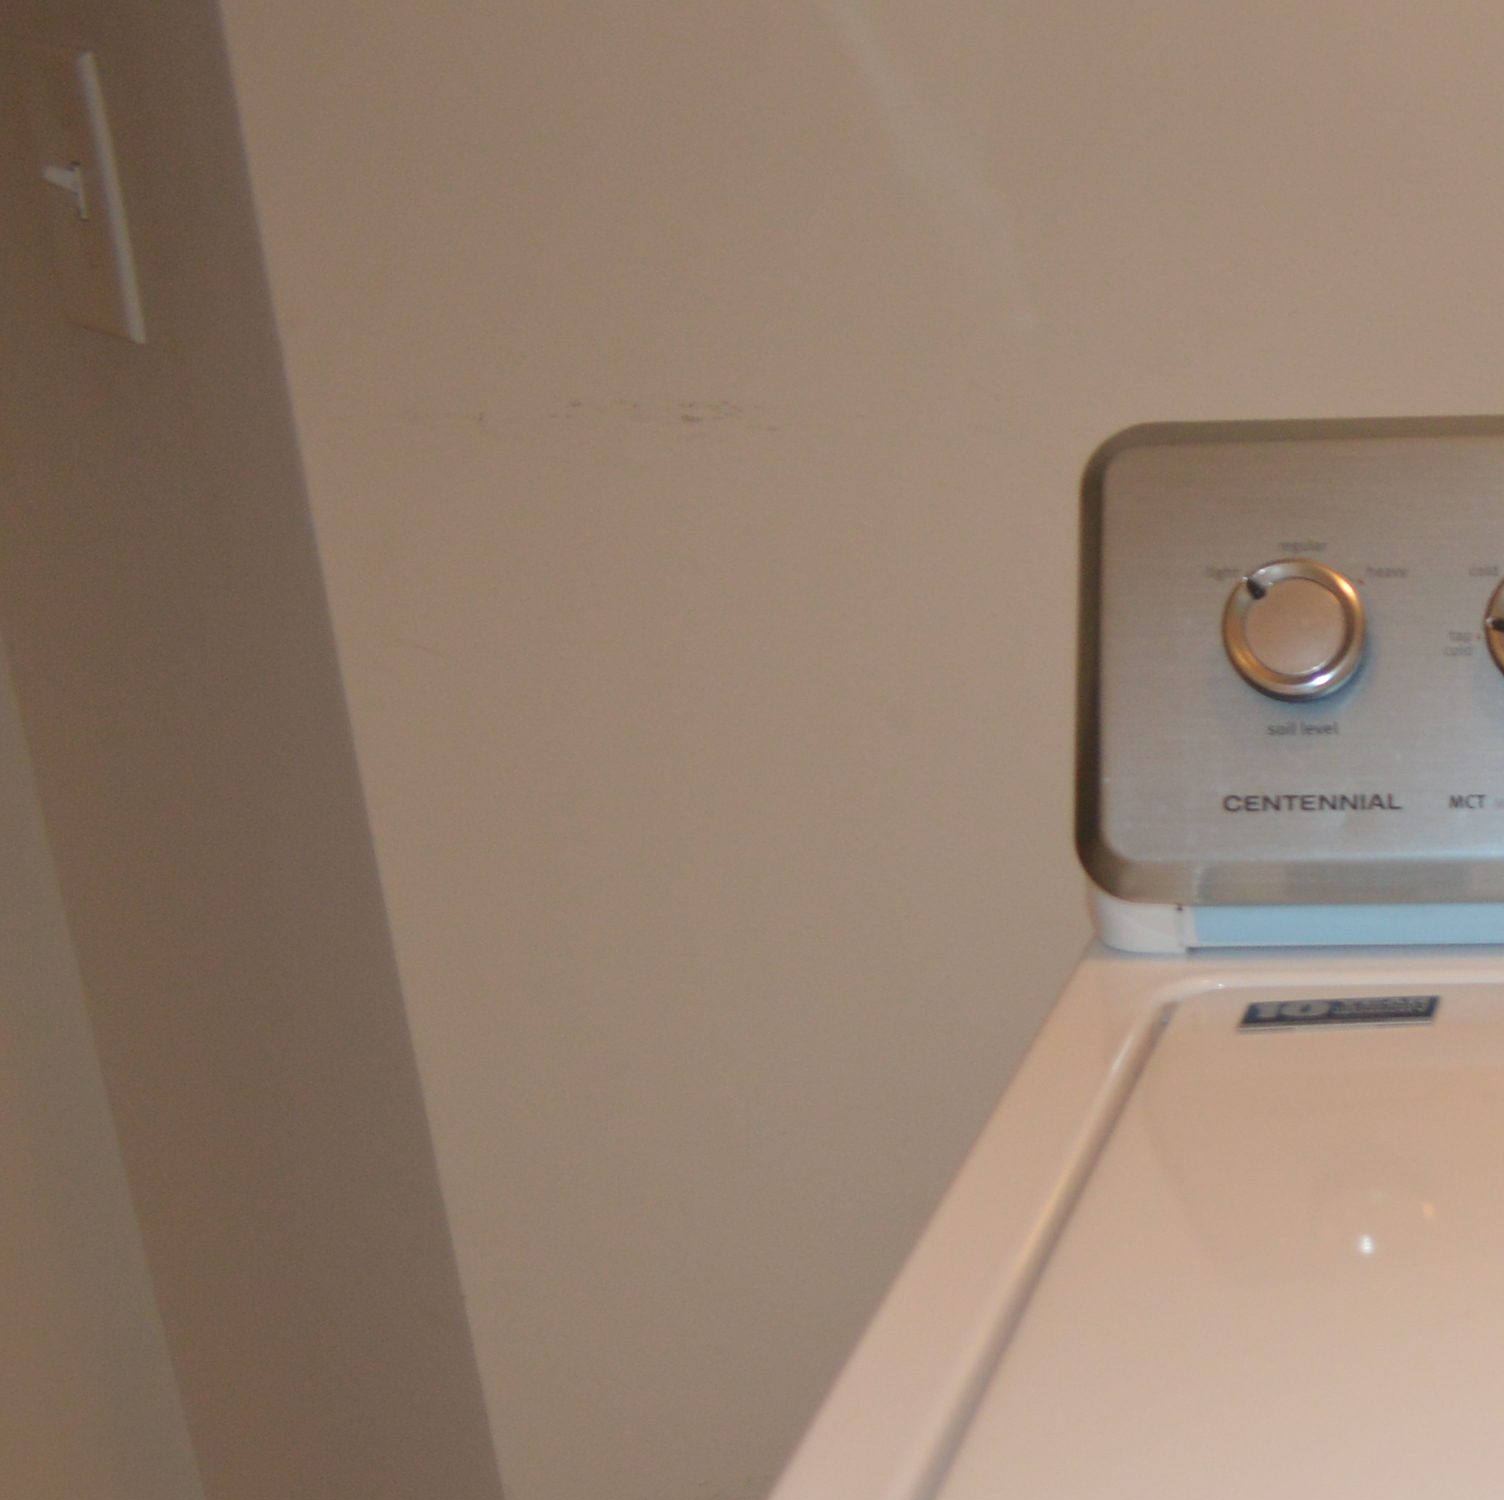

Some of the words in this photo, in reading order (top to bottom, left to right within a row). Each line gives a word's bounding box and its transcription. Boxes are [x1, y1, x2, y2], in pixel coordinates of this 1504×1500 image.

[1267, 721, 1297, 736] soil
[1301, 721, 1340, 735] level
[1221, 793, 1403, 813] CENTENNIAL
[1449, 794, 1487, 809] MCT
